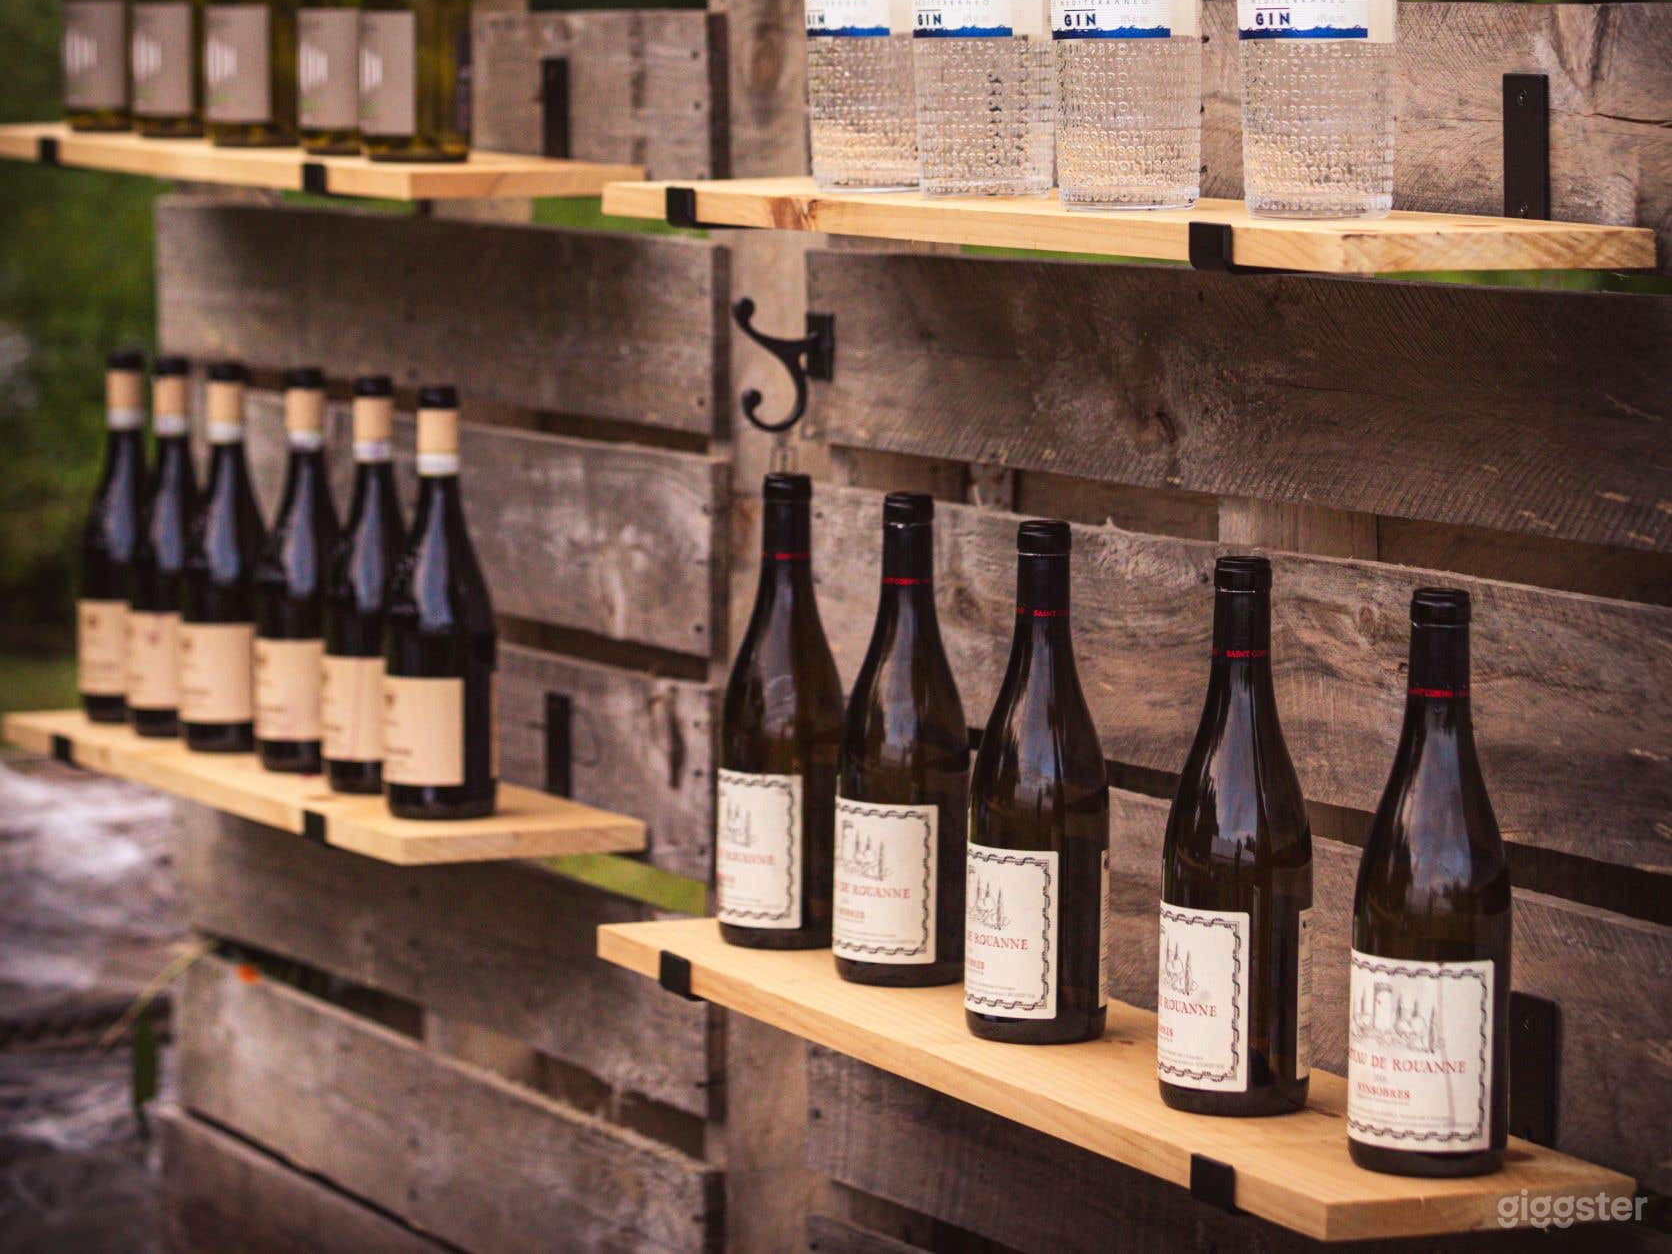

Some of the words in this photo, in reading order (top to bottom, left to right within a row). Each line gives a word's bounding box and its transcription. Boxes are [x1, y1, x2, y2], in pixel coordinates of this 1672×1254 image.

[917, 13, 942, 26] GIN
[1064, 13, 1096, 27] GIN
[1255, 12, 1290, 26] GIN
[975, 933, 1029, 950] ROUANNE
[1163, 996, 1217, 1017] ROUANNE
[1371, 1053, 1387, 1070] DE
[1392, 1057, 1467, 1074] ROUANNE
